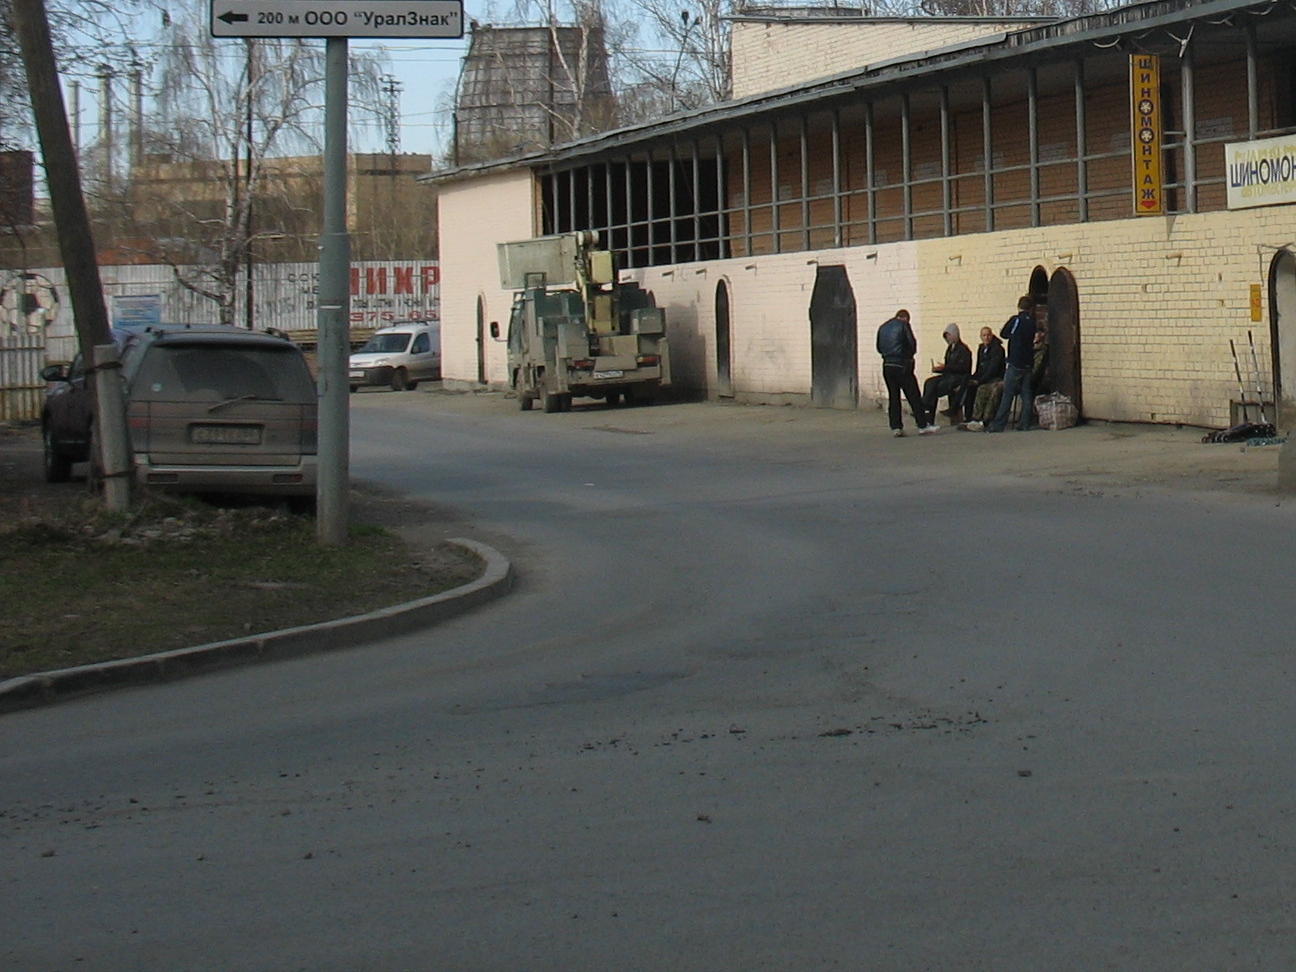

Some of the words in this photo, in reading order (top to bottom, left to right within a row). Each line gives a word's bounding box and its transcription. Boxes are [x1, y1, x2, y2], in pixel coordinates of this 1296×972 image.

[257, 11, 284, 25] 200
[287, 14, 300, 25] м
[304, 10, 348, 27] ООО
